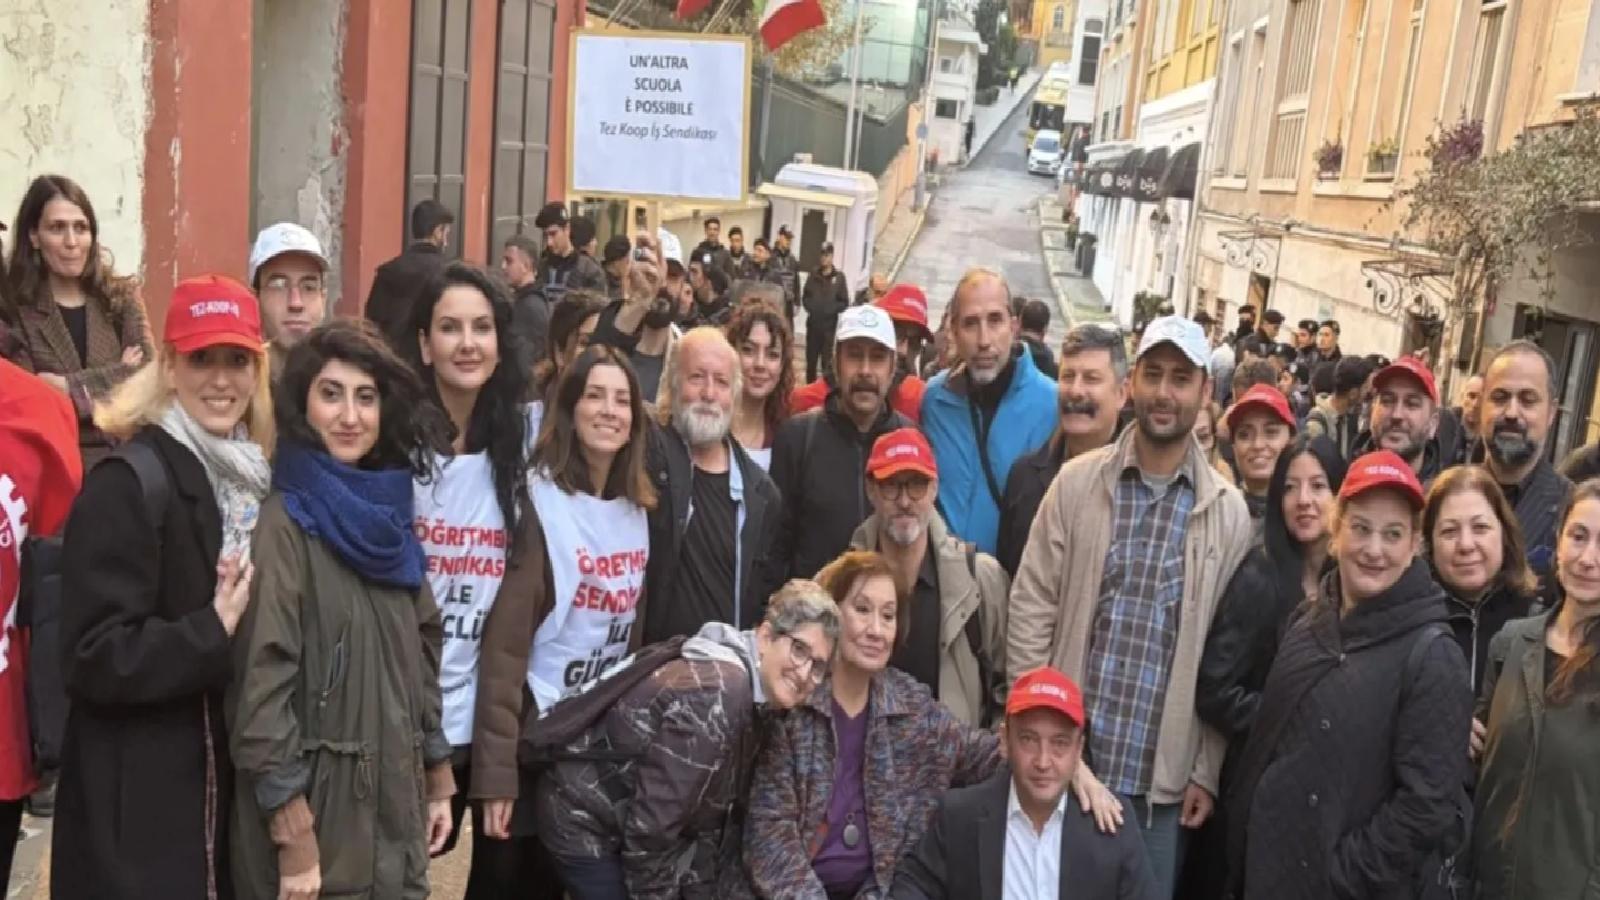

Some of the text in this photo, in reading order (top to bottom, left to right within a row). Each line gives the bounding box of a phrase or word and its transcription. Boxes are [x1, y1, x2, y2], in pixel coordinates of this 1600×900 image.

[629, 55, 689, 69] UN'ALTRA
[635, 77, 682, 92] SCUOLA
[625, 96, 694, 115] È POSSIBILE
[600, 122, 617, 135] Tez
[619, 123, 649, 139] Koop
[424, 551, 505, 577] ENDİKAS
